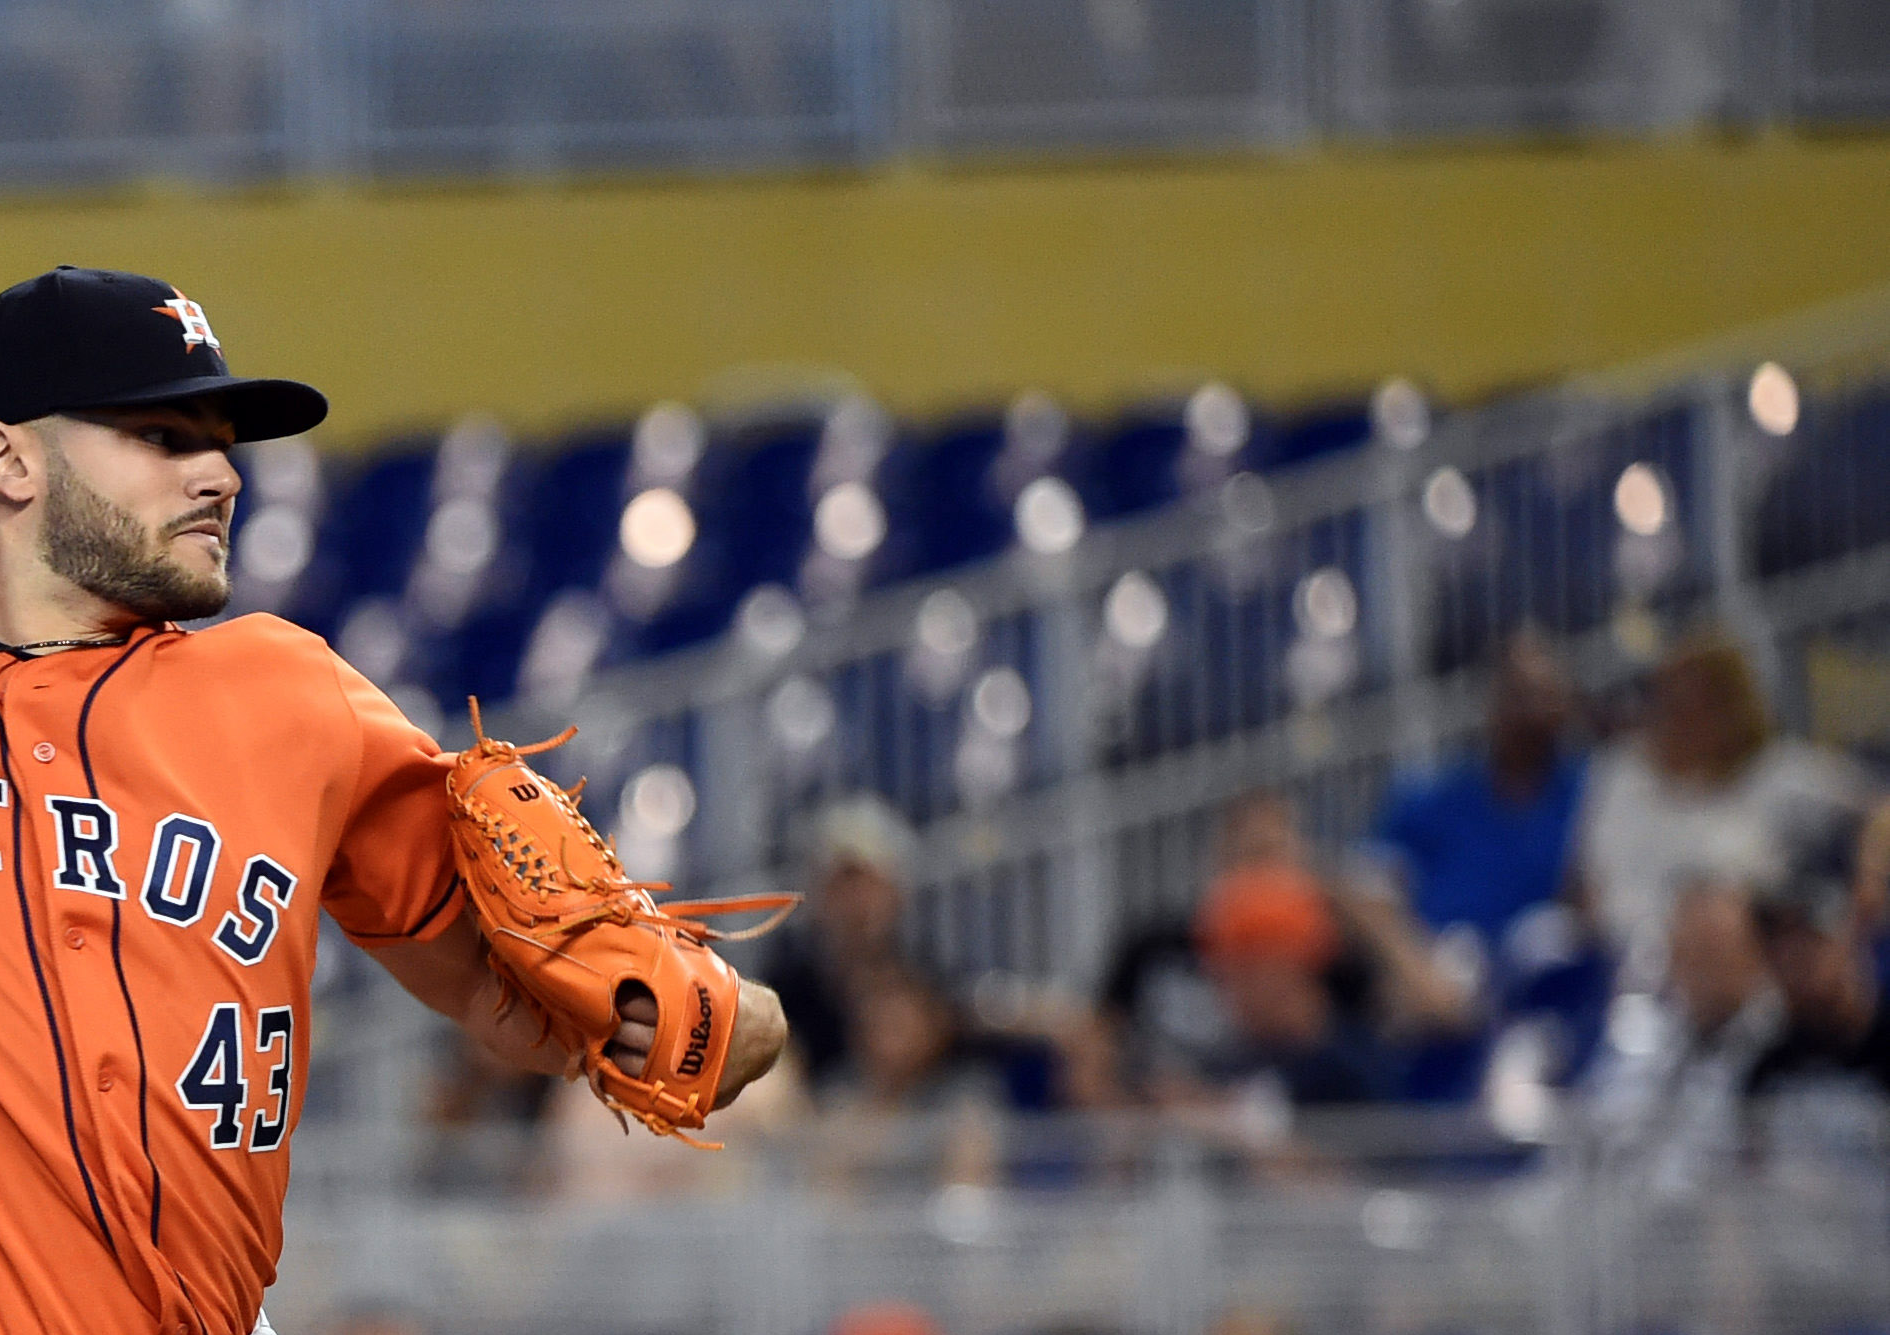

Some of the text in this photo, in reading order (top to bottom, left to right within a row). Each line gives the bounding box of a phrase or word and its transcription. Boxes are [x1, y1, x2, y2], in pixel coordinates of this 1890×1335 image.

[164, 299, 220, 349] H
[676, 981, 712, 1076] Wilson
[175, 1003, 293, 1153] 43
